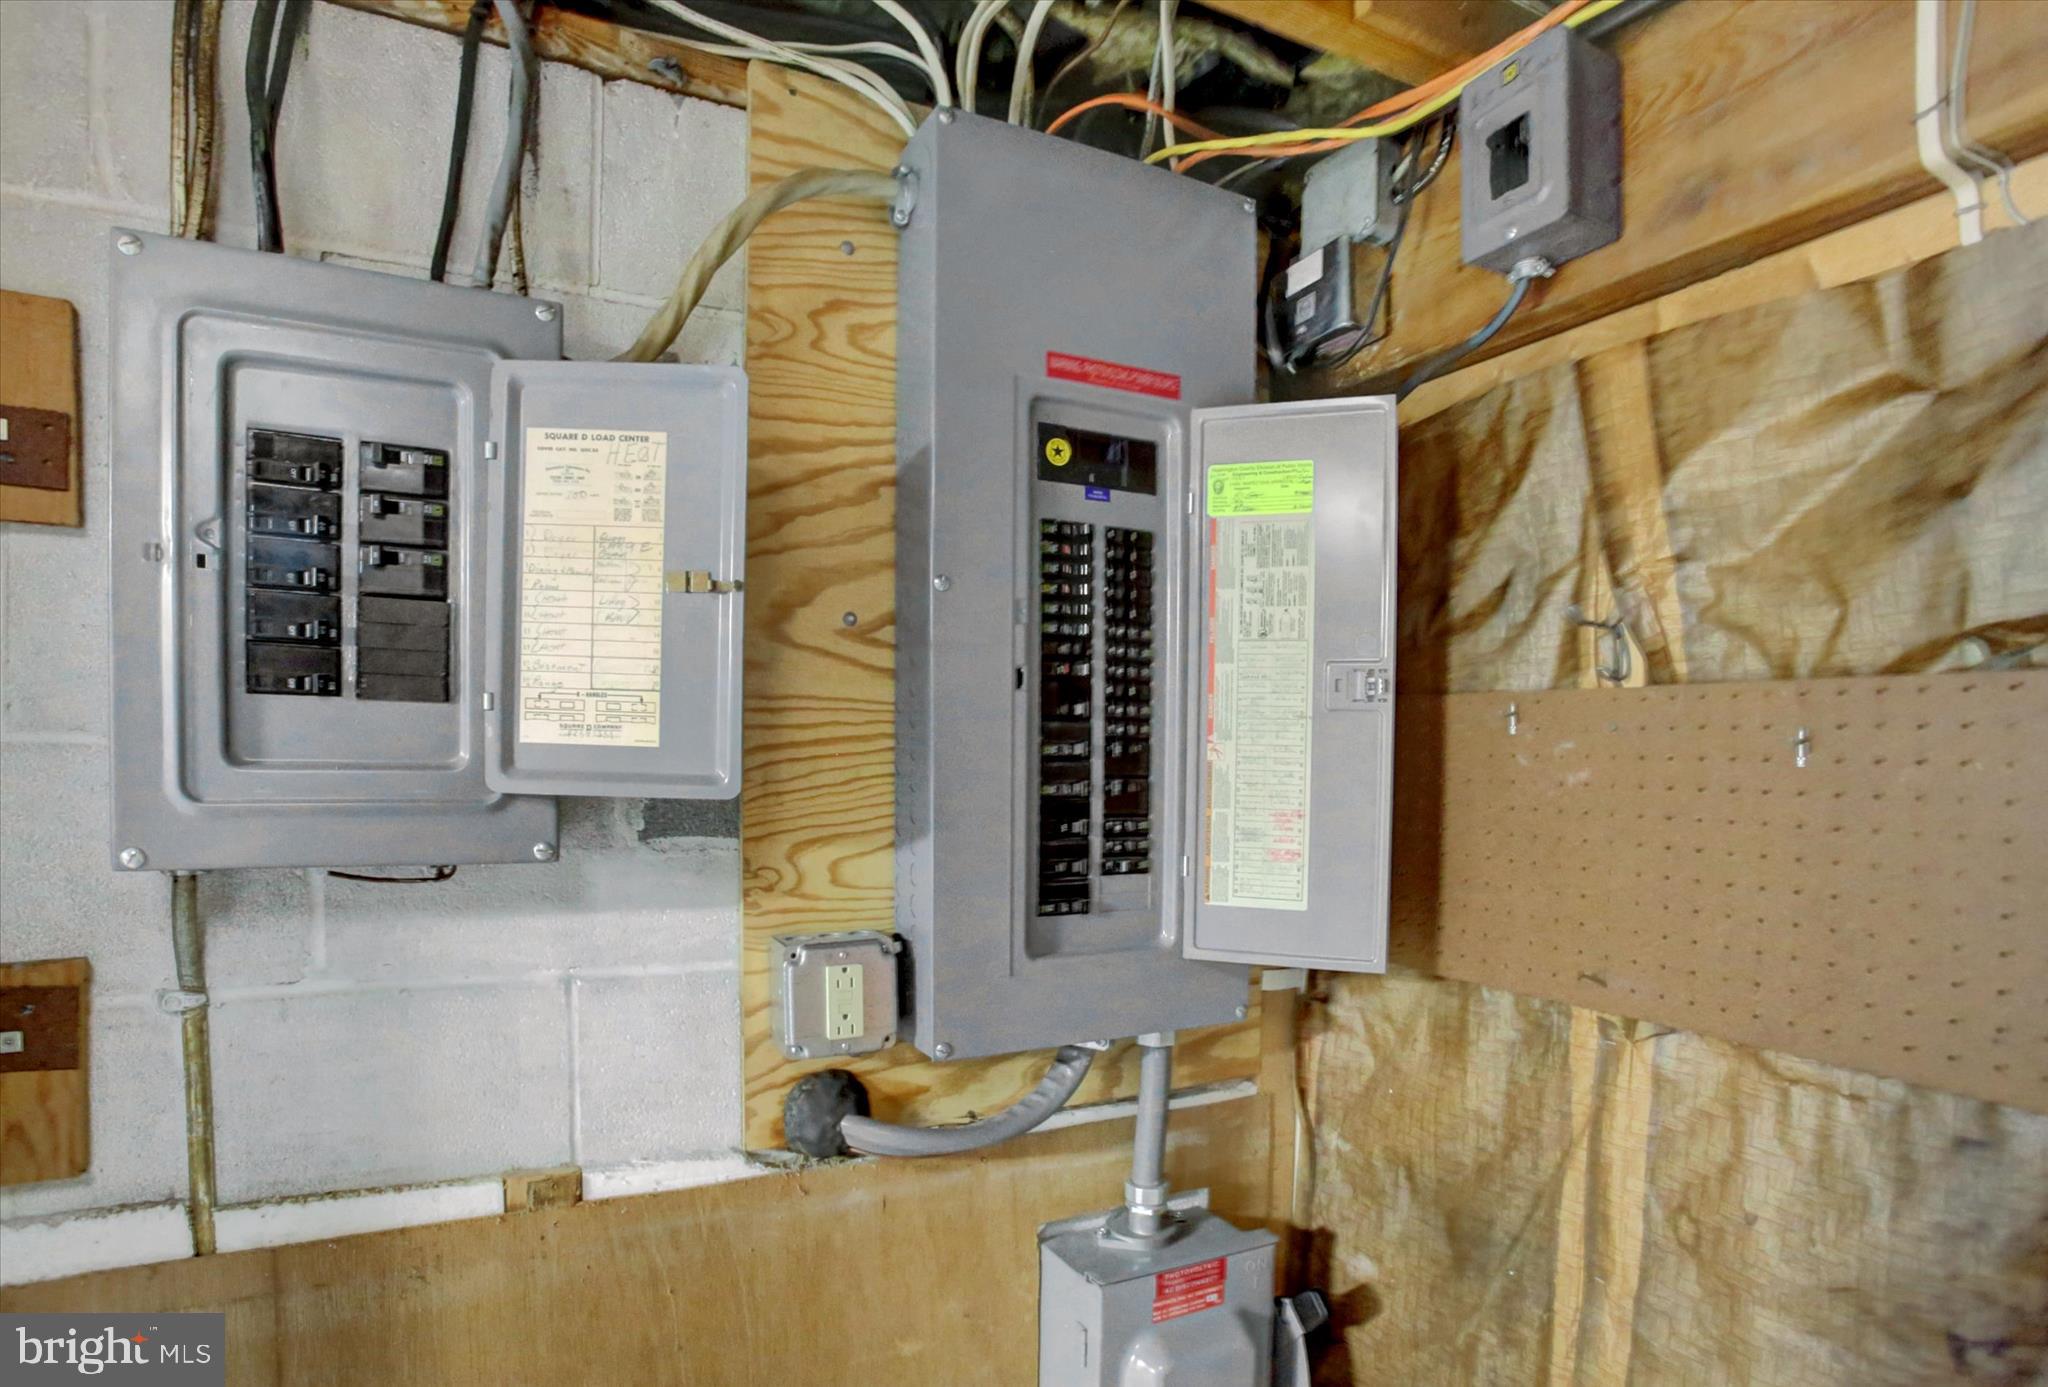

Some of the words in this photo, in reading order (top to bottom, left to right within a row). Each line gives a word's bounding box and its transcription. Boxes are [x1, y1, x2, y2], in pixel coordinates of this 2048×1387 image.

[544, 432, 578, 441] SQUARE
[581, 433, 588, 441] D
[591, 433, 616, 442] LOAD
[618, 434, 650, 443] CENTER
